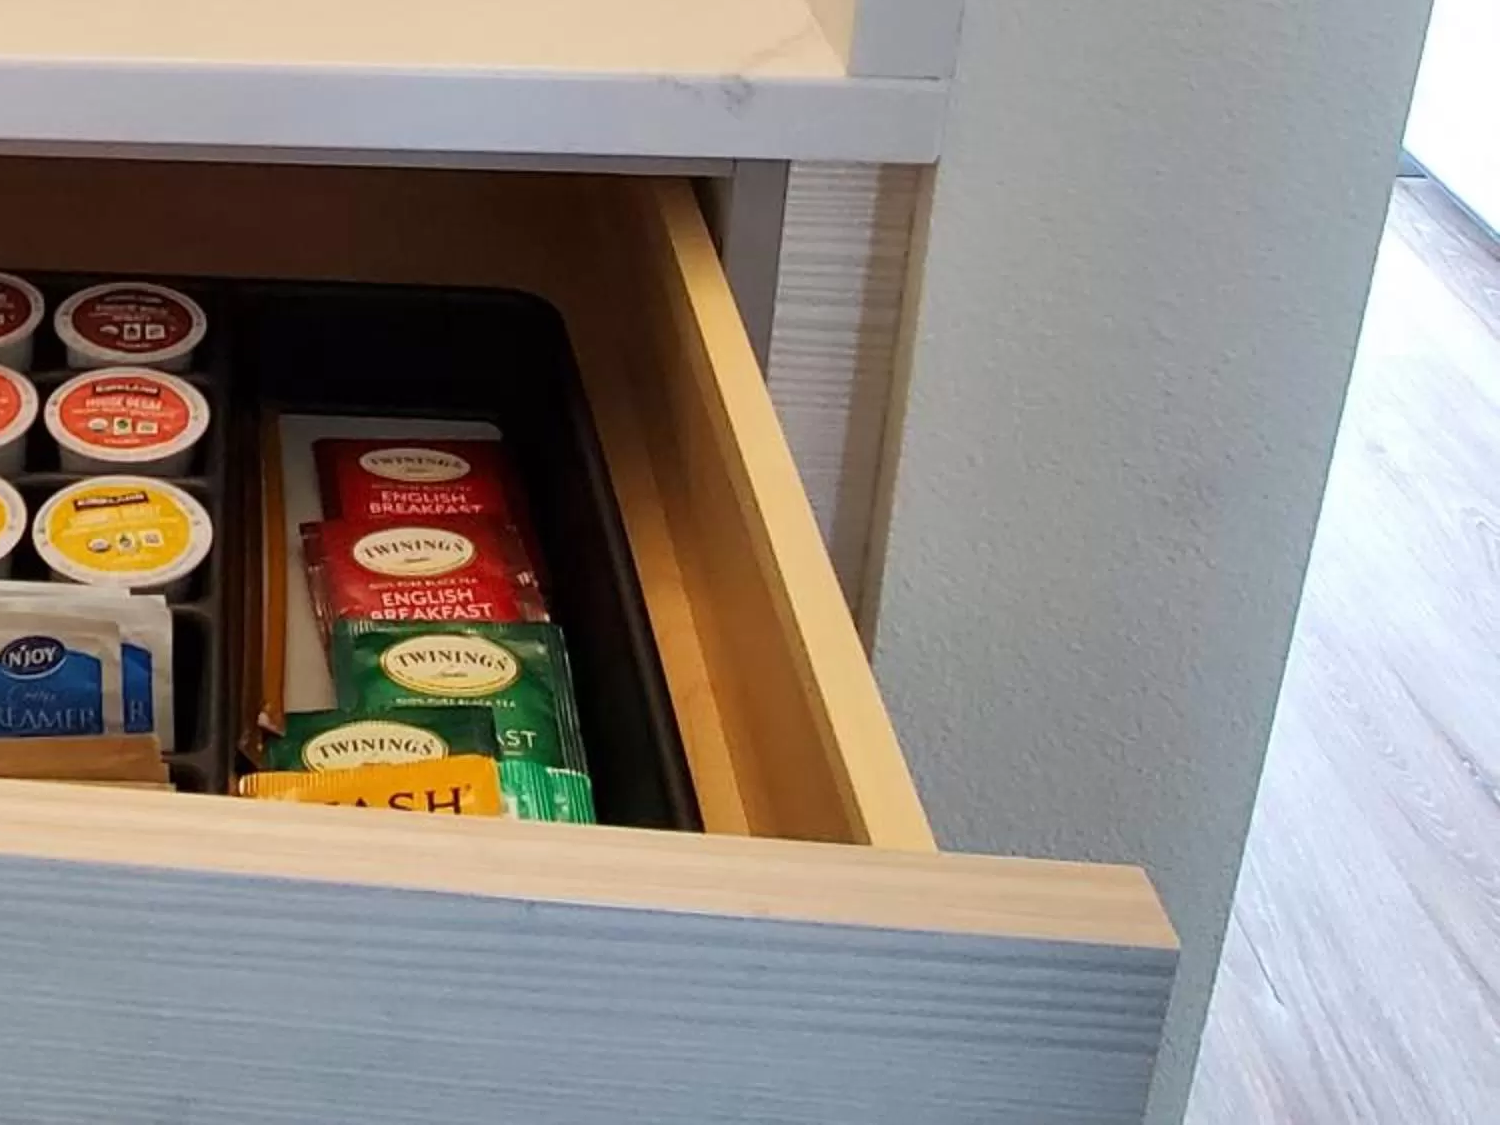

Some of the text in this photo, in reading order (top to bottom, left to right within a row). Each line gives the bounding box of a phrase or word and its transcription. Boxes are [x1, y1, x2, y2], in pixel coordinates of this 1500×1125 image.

[381, 490, 467, 504] ENGLISH
[369, 502, 484, 515] BREAKFAST
[364, 539, 465, 560] TWININGS
[381, 588, 474, 607] ENGLISH
[395, 650, 506, 671] TWININGS
[317, 738, 434, 759] TWININGS
